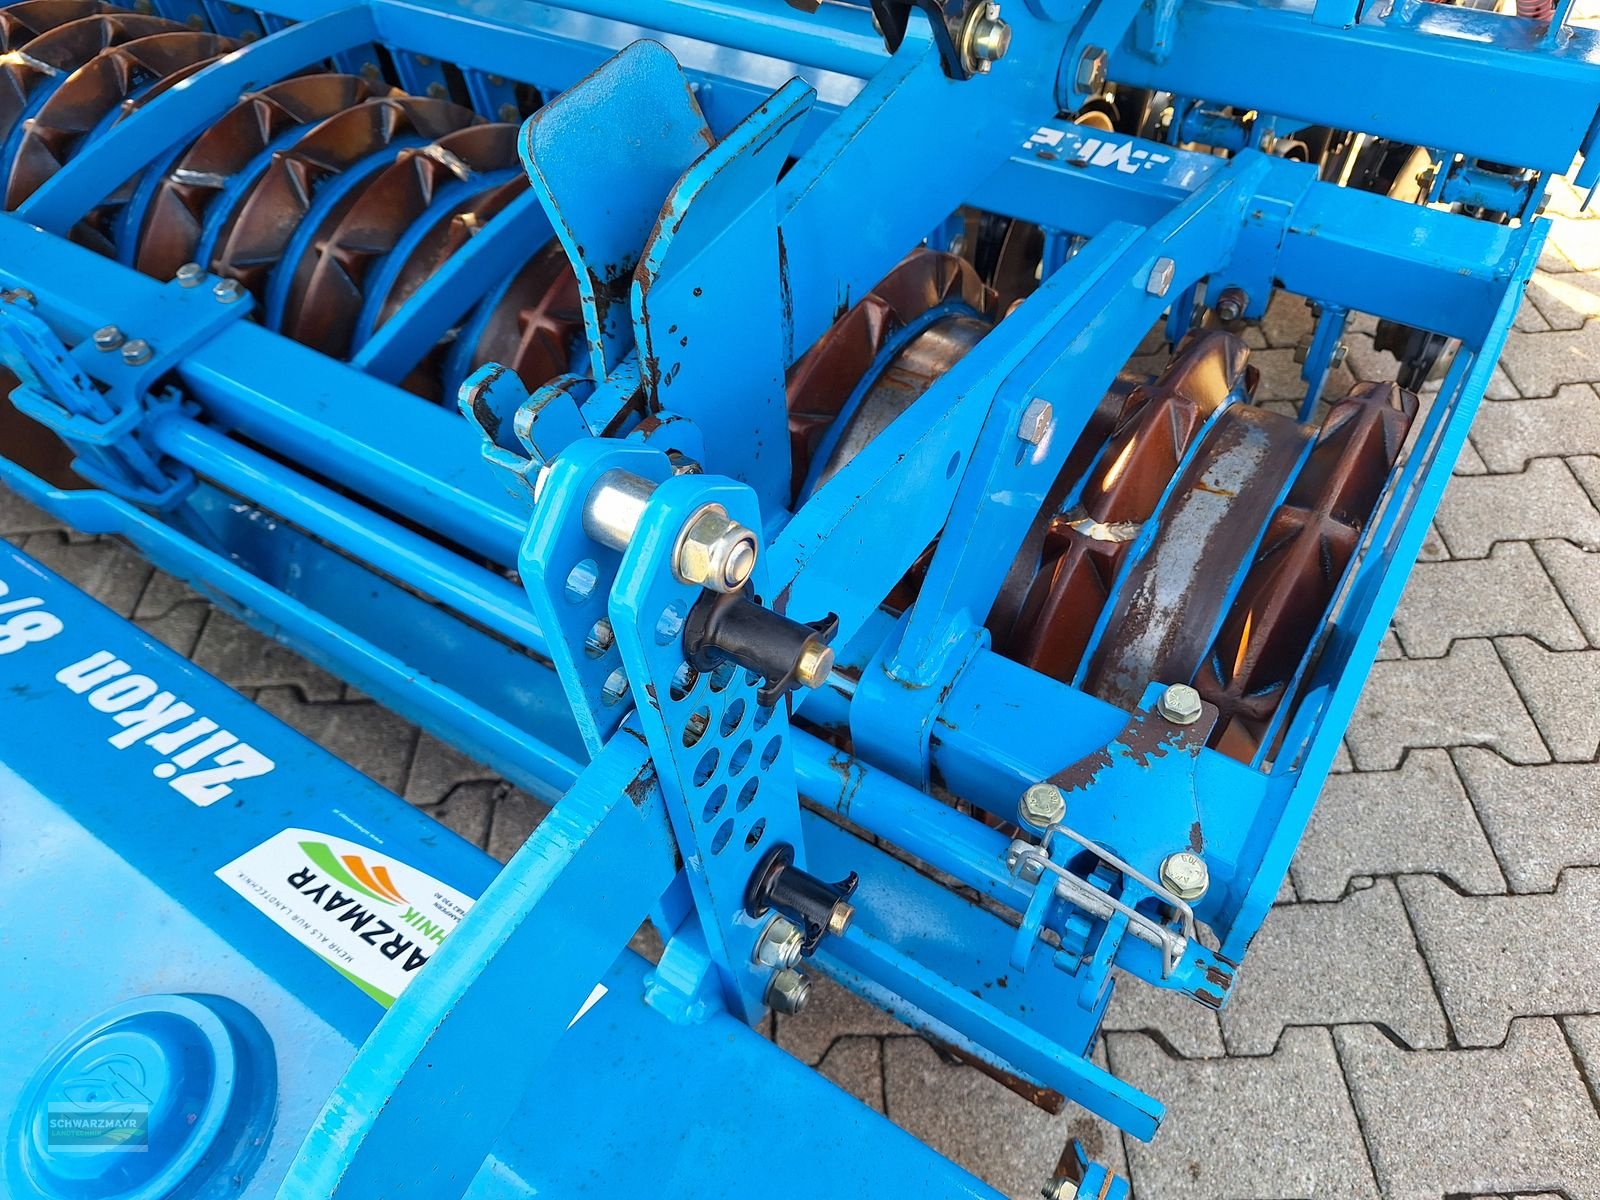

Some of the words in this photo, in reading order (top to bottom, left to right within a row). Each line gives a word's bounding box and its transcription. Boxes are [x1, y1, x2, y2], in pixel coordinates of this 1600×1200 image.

[0, 578, 64, 655] 8/
[55, 649, 276, 808] Zirkon
[291, 913, 312, 930] NUR
[310, 927, 330, 943] ALS
[328, 942, 354, 963] MEHR
